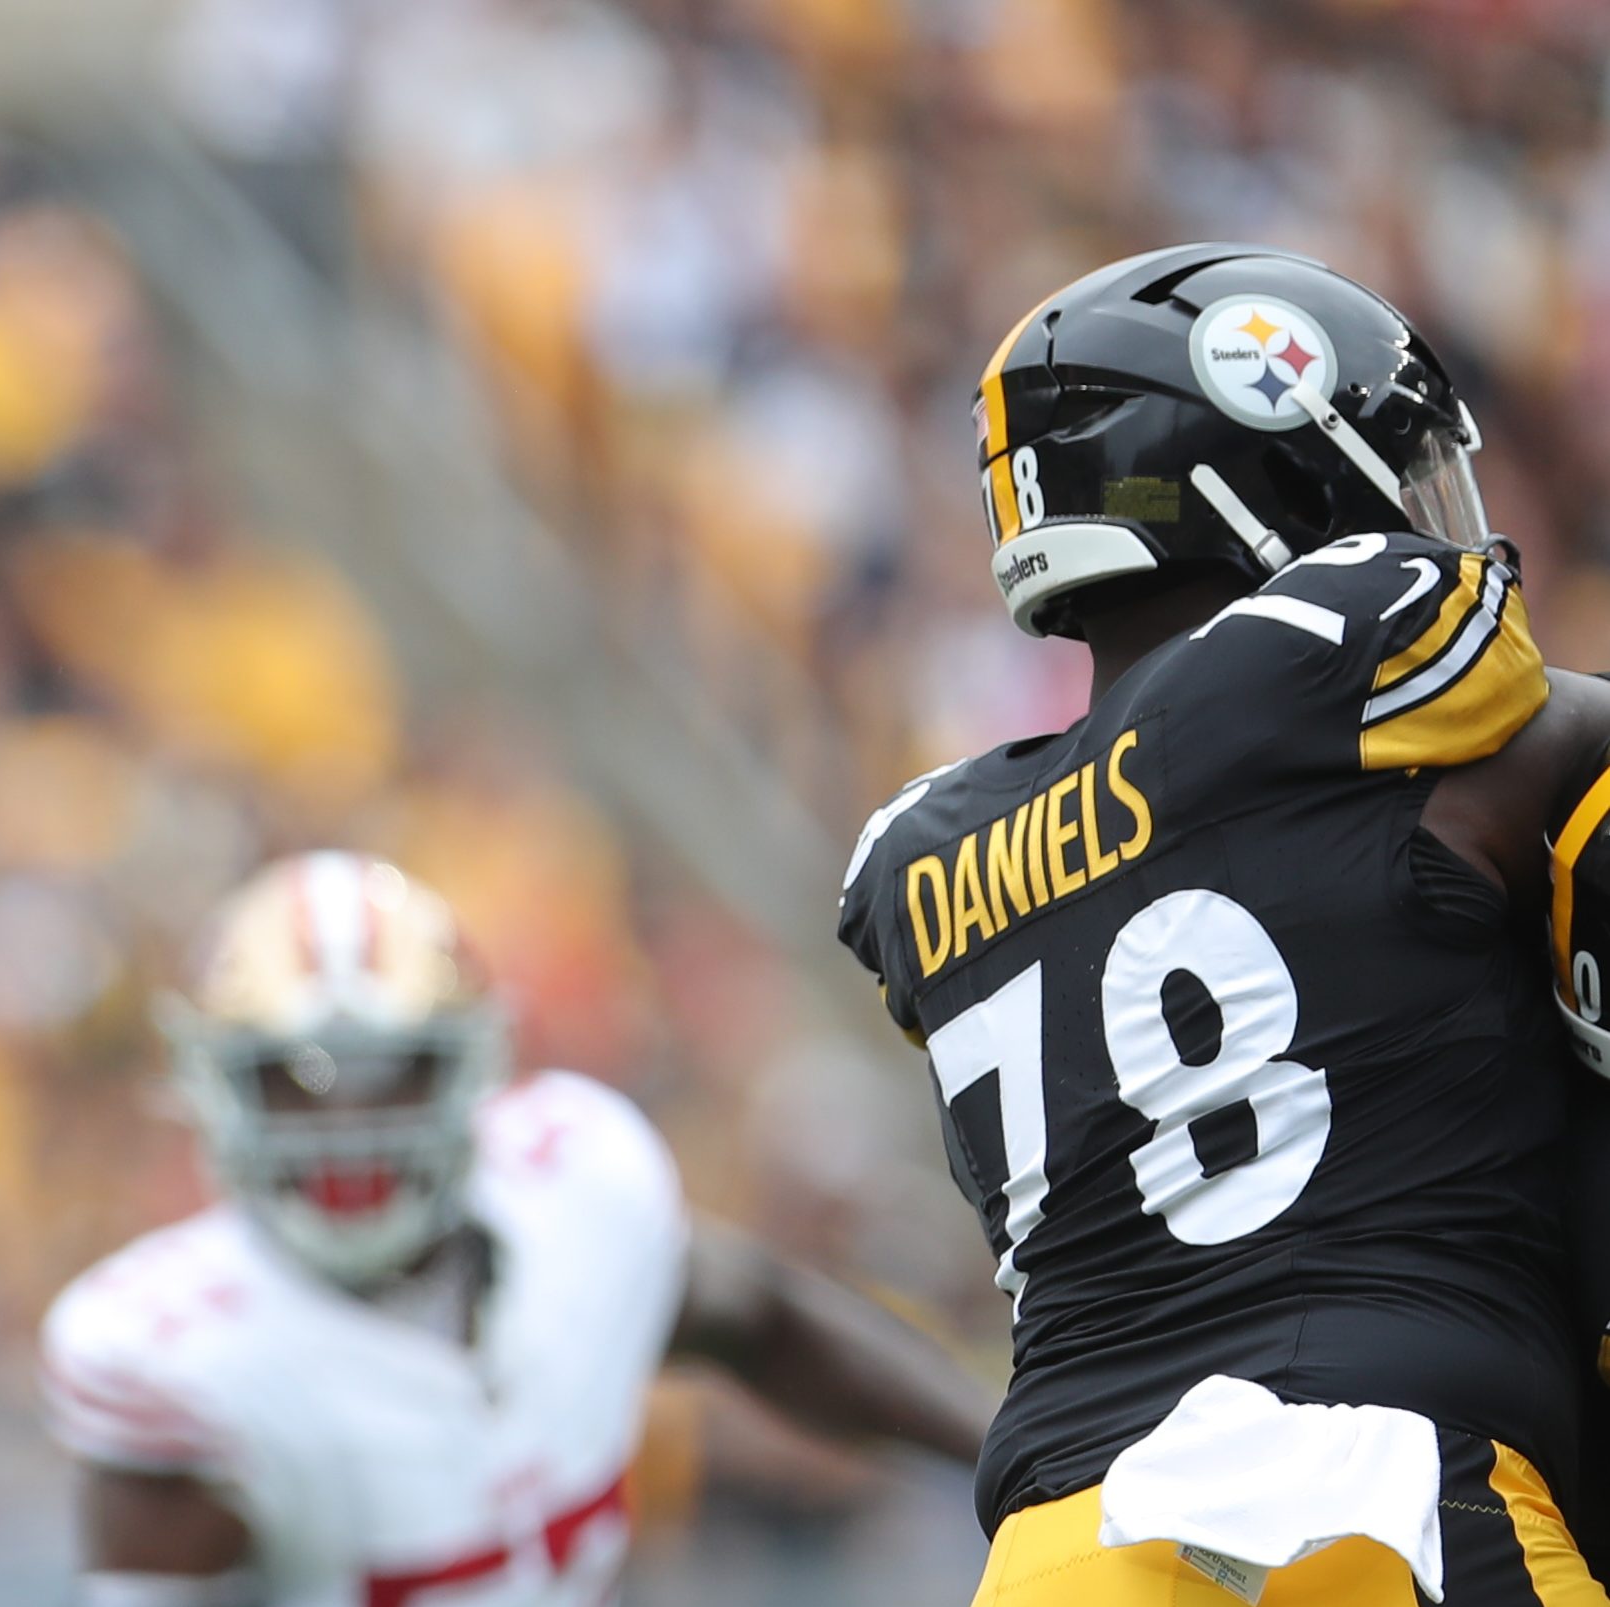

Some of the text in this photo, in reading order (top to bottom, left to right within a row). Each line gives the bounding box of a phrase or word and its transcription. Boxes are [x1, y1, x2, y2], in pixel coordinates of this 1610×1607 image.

[1211, 347, 1261, 362] Steelers
[905, 729, 1154, 979] DANIELS
[926, 888, 1332, 1325] 78
